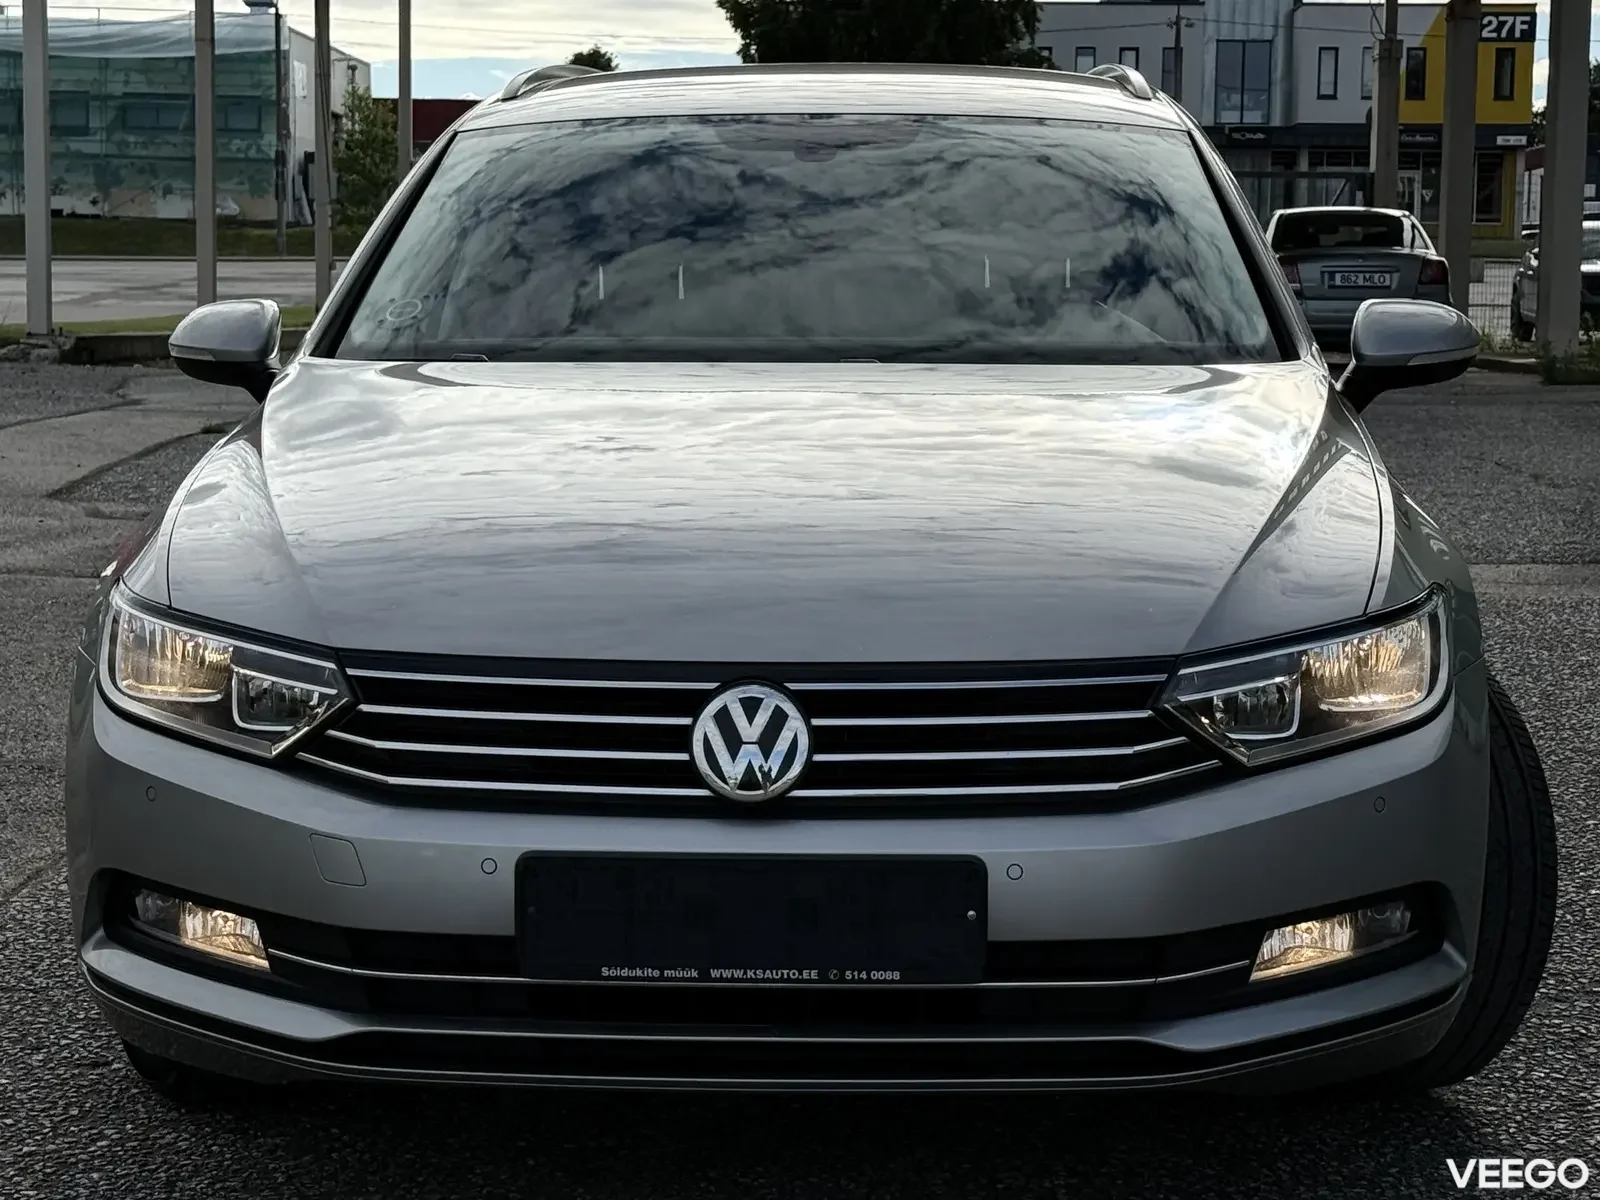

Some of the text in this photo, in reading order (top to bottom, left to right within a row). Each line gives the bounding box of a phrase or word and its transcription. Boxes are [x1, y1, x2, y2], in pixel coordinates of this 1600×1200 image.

[1481, 15, 1531, 38] 27F
[1339, 274, 1386, 285] 862 MLO
[663, 967, 698, 978] müük
[709, 968, 819, 979] WWW.KSAUTO.EE
[844, 970, 867, 979] 514
[870, 970, 900, 980] 0088
